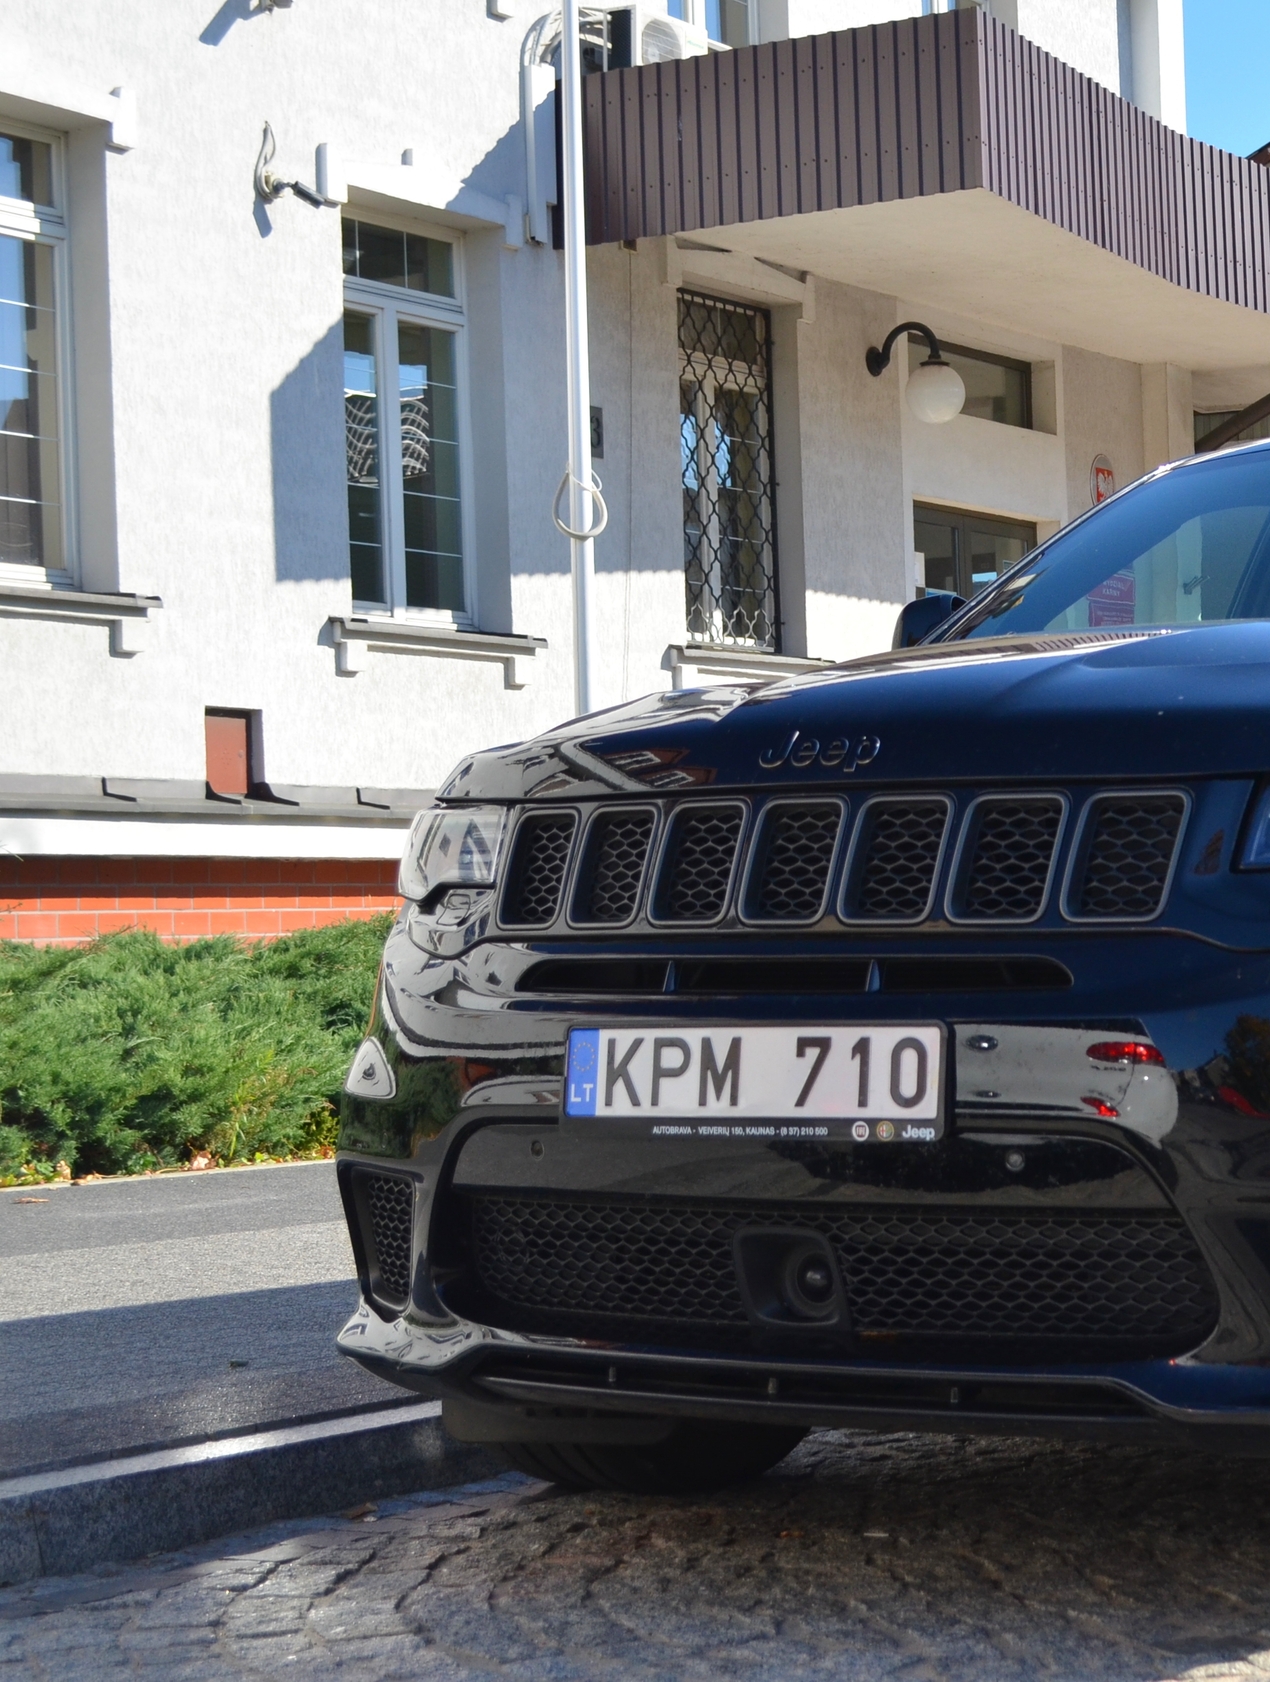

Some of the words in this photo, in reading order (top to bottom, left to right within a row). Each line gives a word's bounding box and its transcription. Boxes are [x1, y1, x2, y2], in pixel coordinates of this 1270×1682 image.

[759, 730, 881, 772] Jeep
[604, 1036, 743, 1107] KPM
[794, 1036, 929, 1109] 710
[570, 1083, 594, 1103] LT
[652, 1125, 692, 1135] AUTOBRAVA
[731, 1126, 745, 1136] 150,
[746, 1126, 776, 1136] KAUNAS
[801, 1126, 814, 1136] 210
[815, 1126, 828, 1136] 500
[902, 1124, 936, 1140] Jeep
